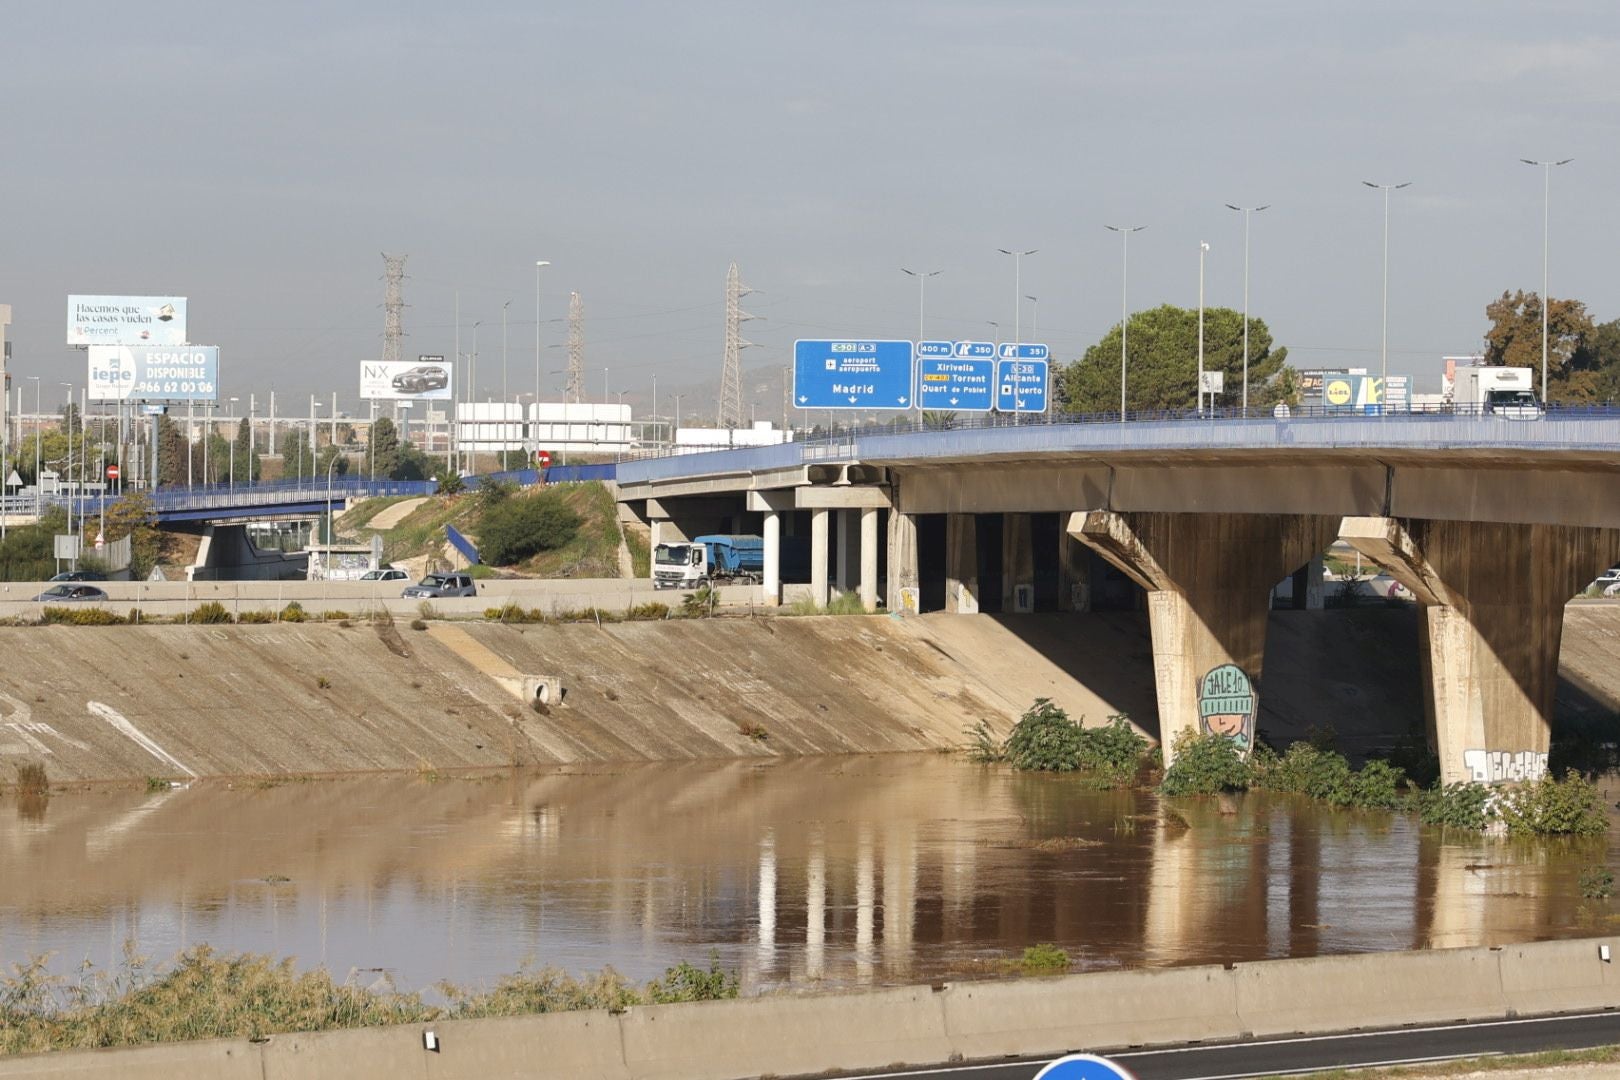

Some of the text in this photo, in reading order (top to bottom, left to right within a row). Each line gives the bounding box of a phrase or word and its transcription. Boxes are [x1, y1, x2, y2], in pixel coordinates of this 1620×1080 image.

[76, 303, 140, 314] Hacemos que
[76, 314, 90, 322] las
[121, 314, 152, 324] vuelen
[84, 326, 118, 335] Percent
[146, 352, 206, 365] ESPACIO
[843, 357, 876, 365] aeroport
[364, 364, 389, 379] NX
[936, 363, 974, 372] Xirivella
[92, 367, 132, 384] iepe
[146, 368, 206, 379] DISPONIBLE
[952, 374, 986, 383] Torrent
[140, 382, 160, 393] 966
[164, 382, 178, 393] 62
[832, 384, 874, 394] Madrid
